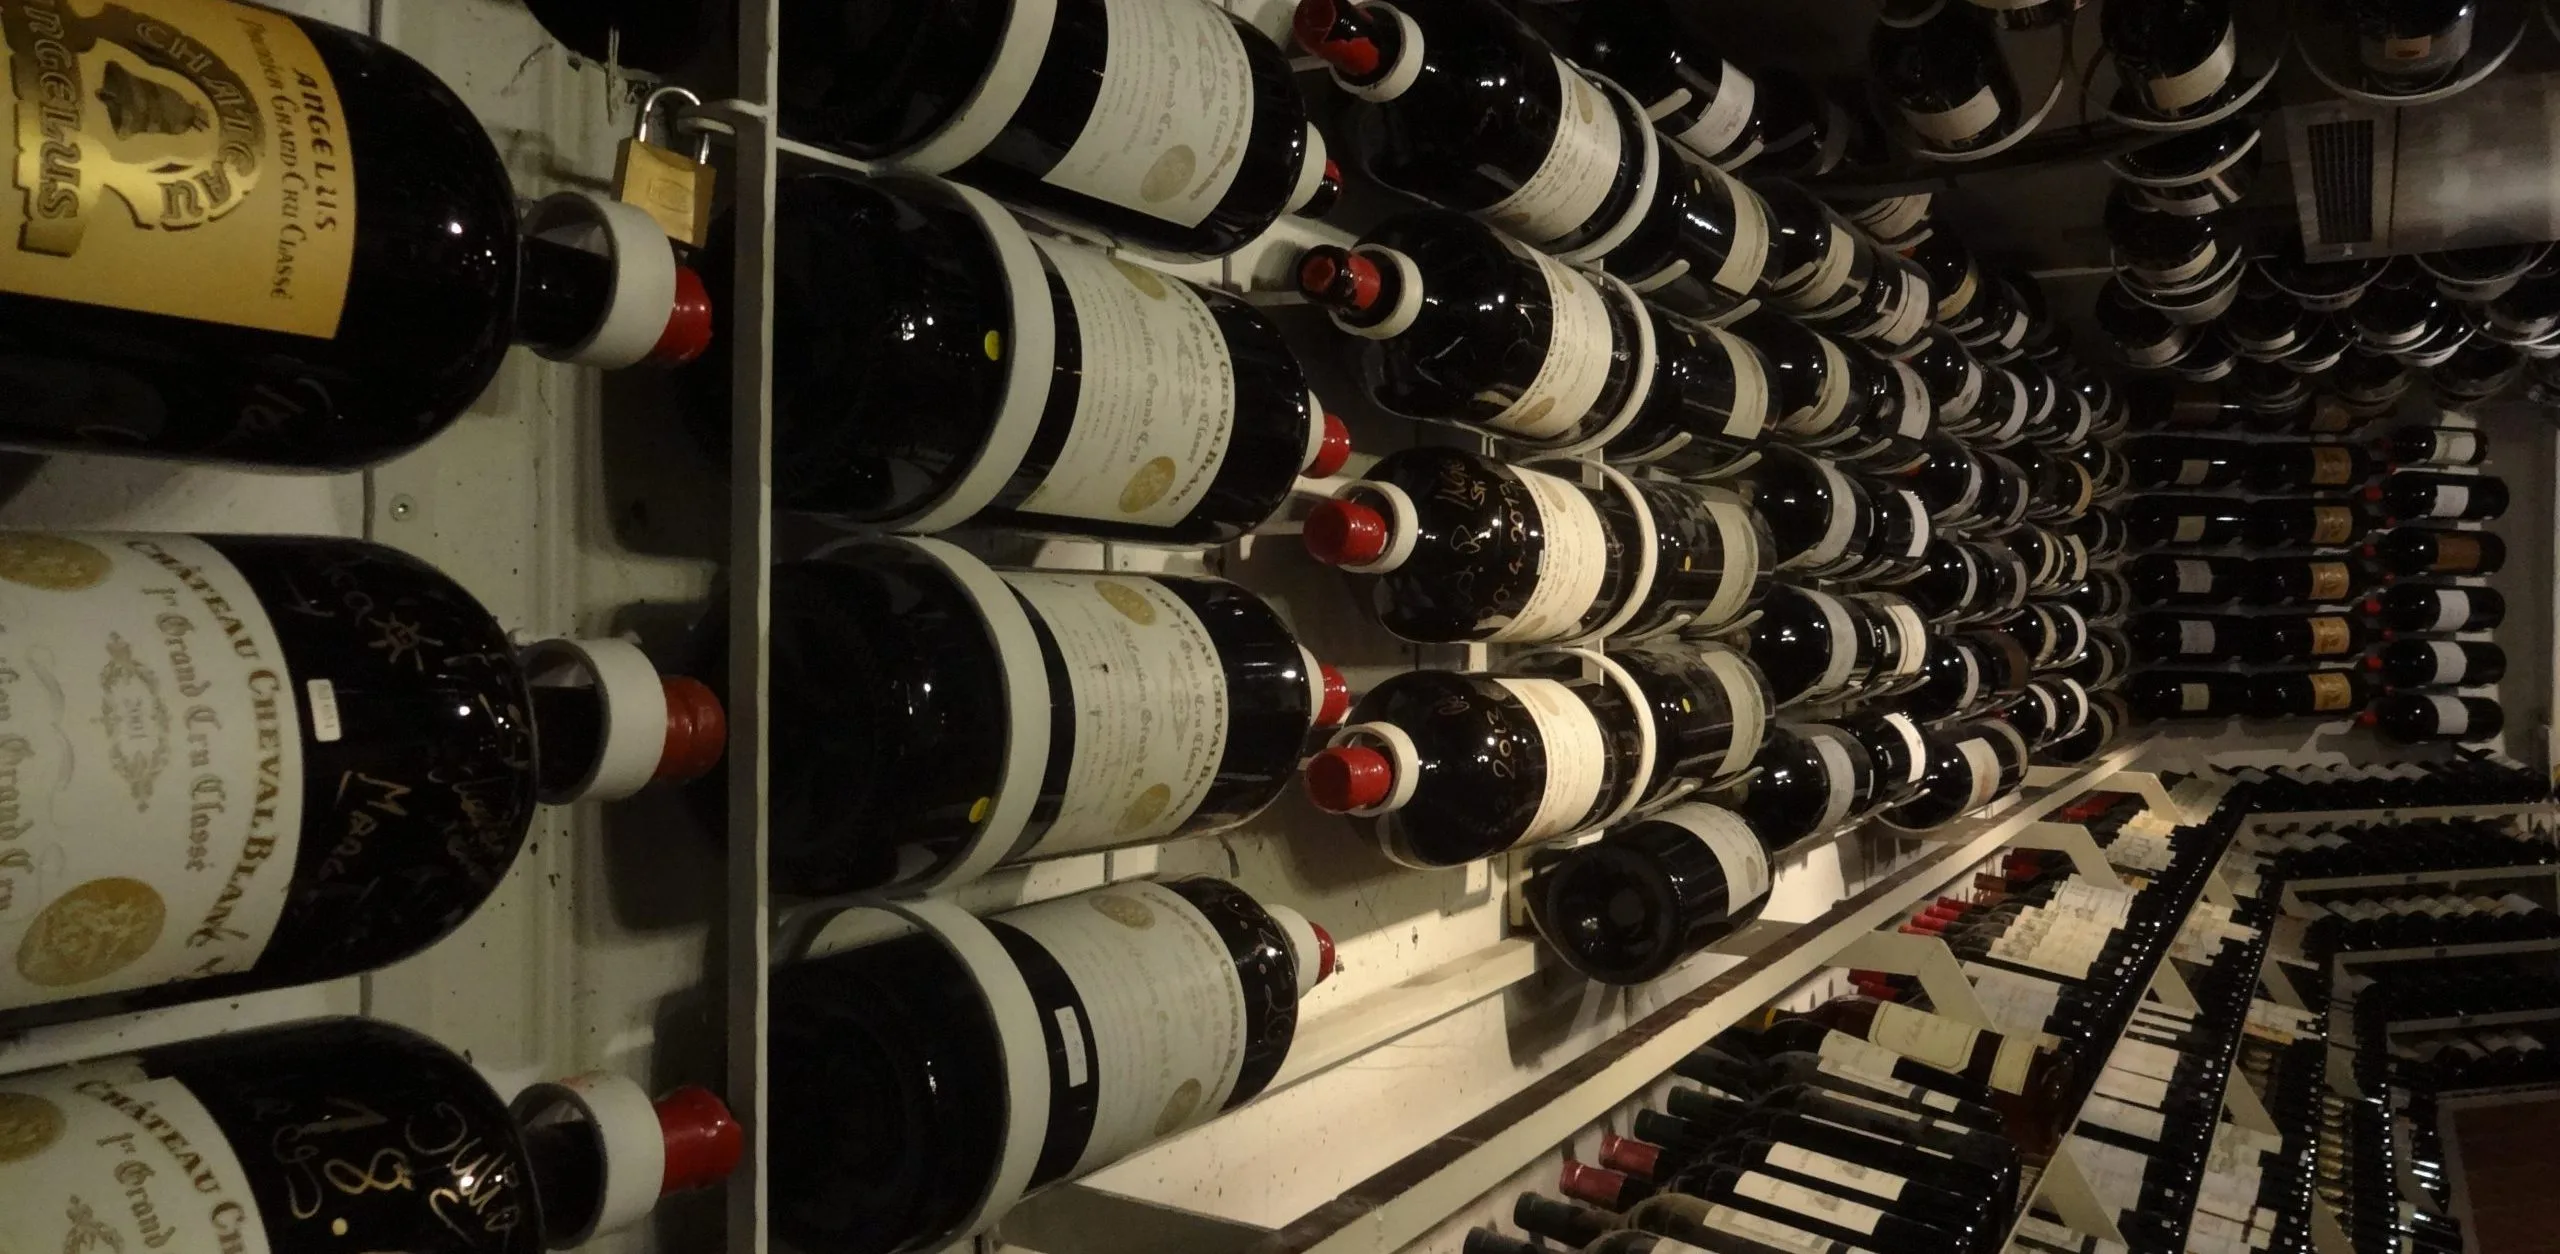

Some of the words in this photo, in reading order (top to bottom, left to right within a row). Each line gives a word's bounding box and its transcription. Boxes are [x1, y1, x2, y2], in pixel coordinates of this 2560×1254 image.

[24, 0, 82, 219] NGELUS
[292, 67, 338, 232] ANGELUS
[246, 668, 283, 828] CHEVAL
[185, 833, 277, 949] BLANC
